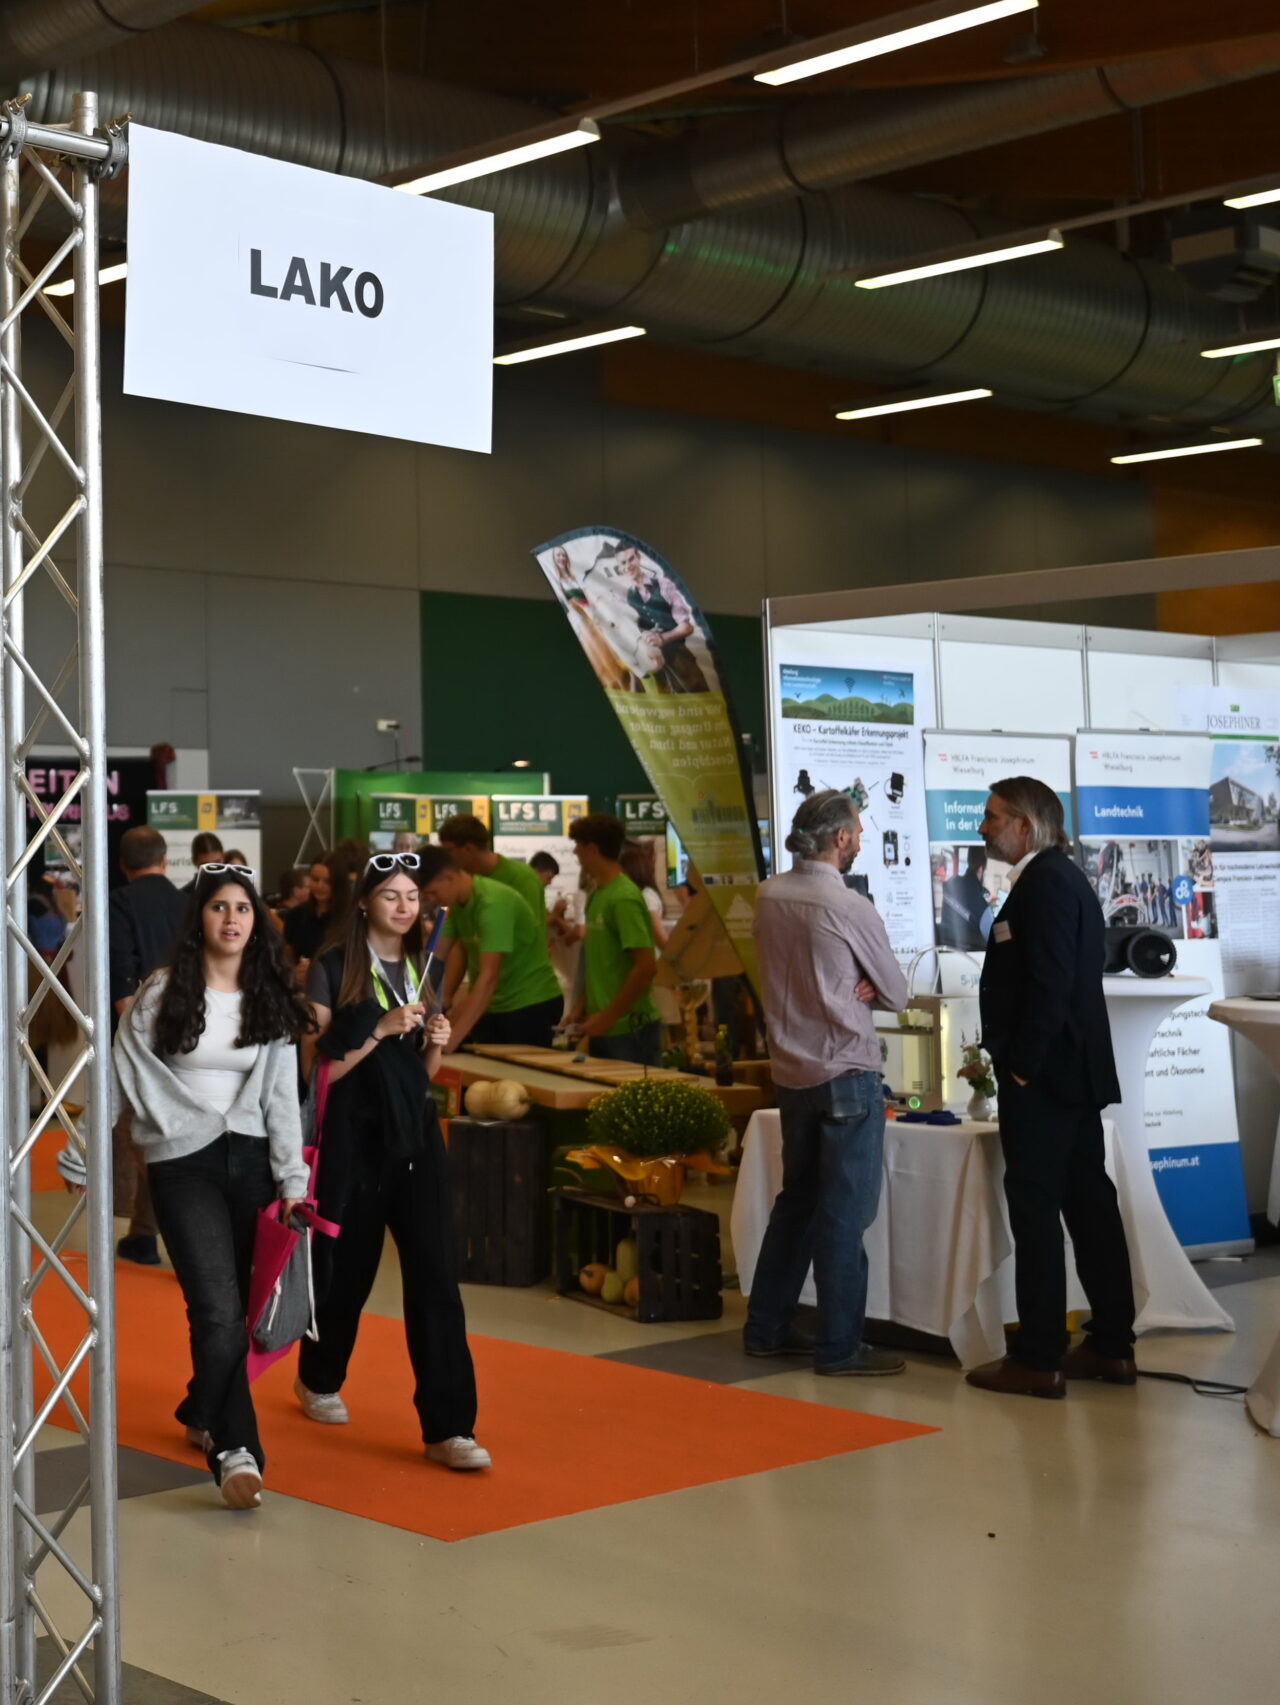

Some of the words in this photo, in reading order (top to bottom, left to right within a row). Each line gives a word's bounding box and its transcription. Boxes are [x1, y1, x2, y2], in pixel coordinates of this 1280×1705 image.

[250, 248, 384, 319] LAKO
[379, 802, 401, 818] LFS
[498, 802, 535, 821] LFS
[625, 801, 665, 819] LFS
[944, 801, 986, 814] Informati
[1094, 804, 1144, 818] Landtechnik
[957, 818, 973, 831] der
